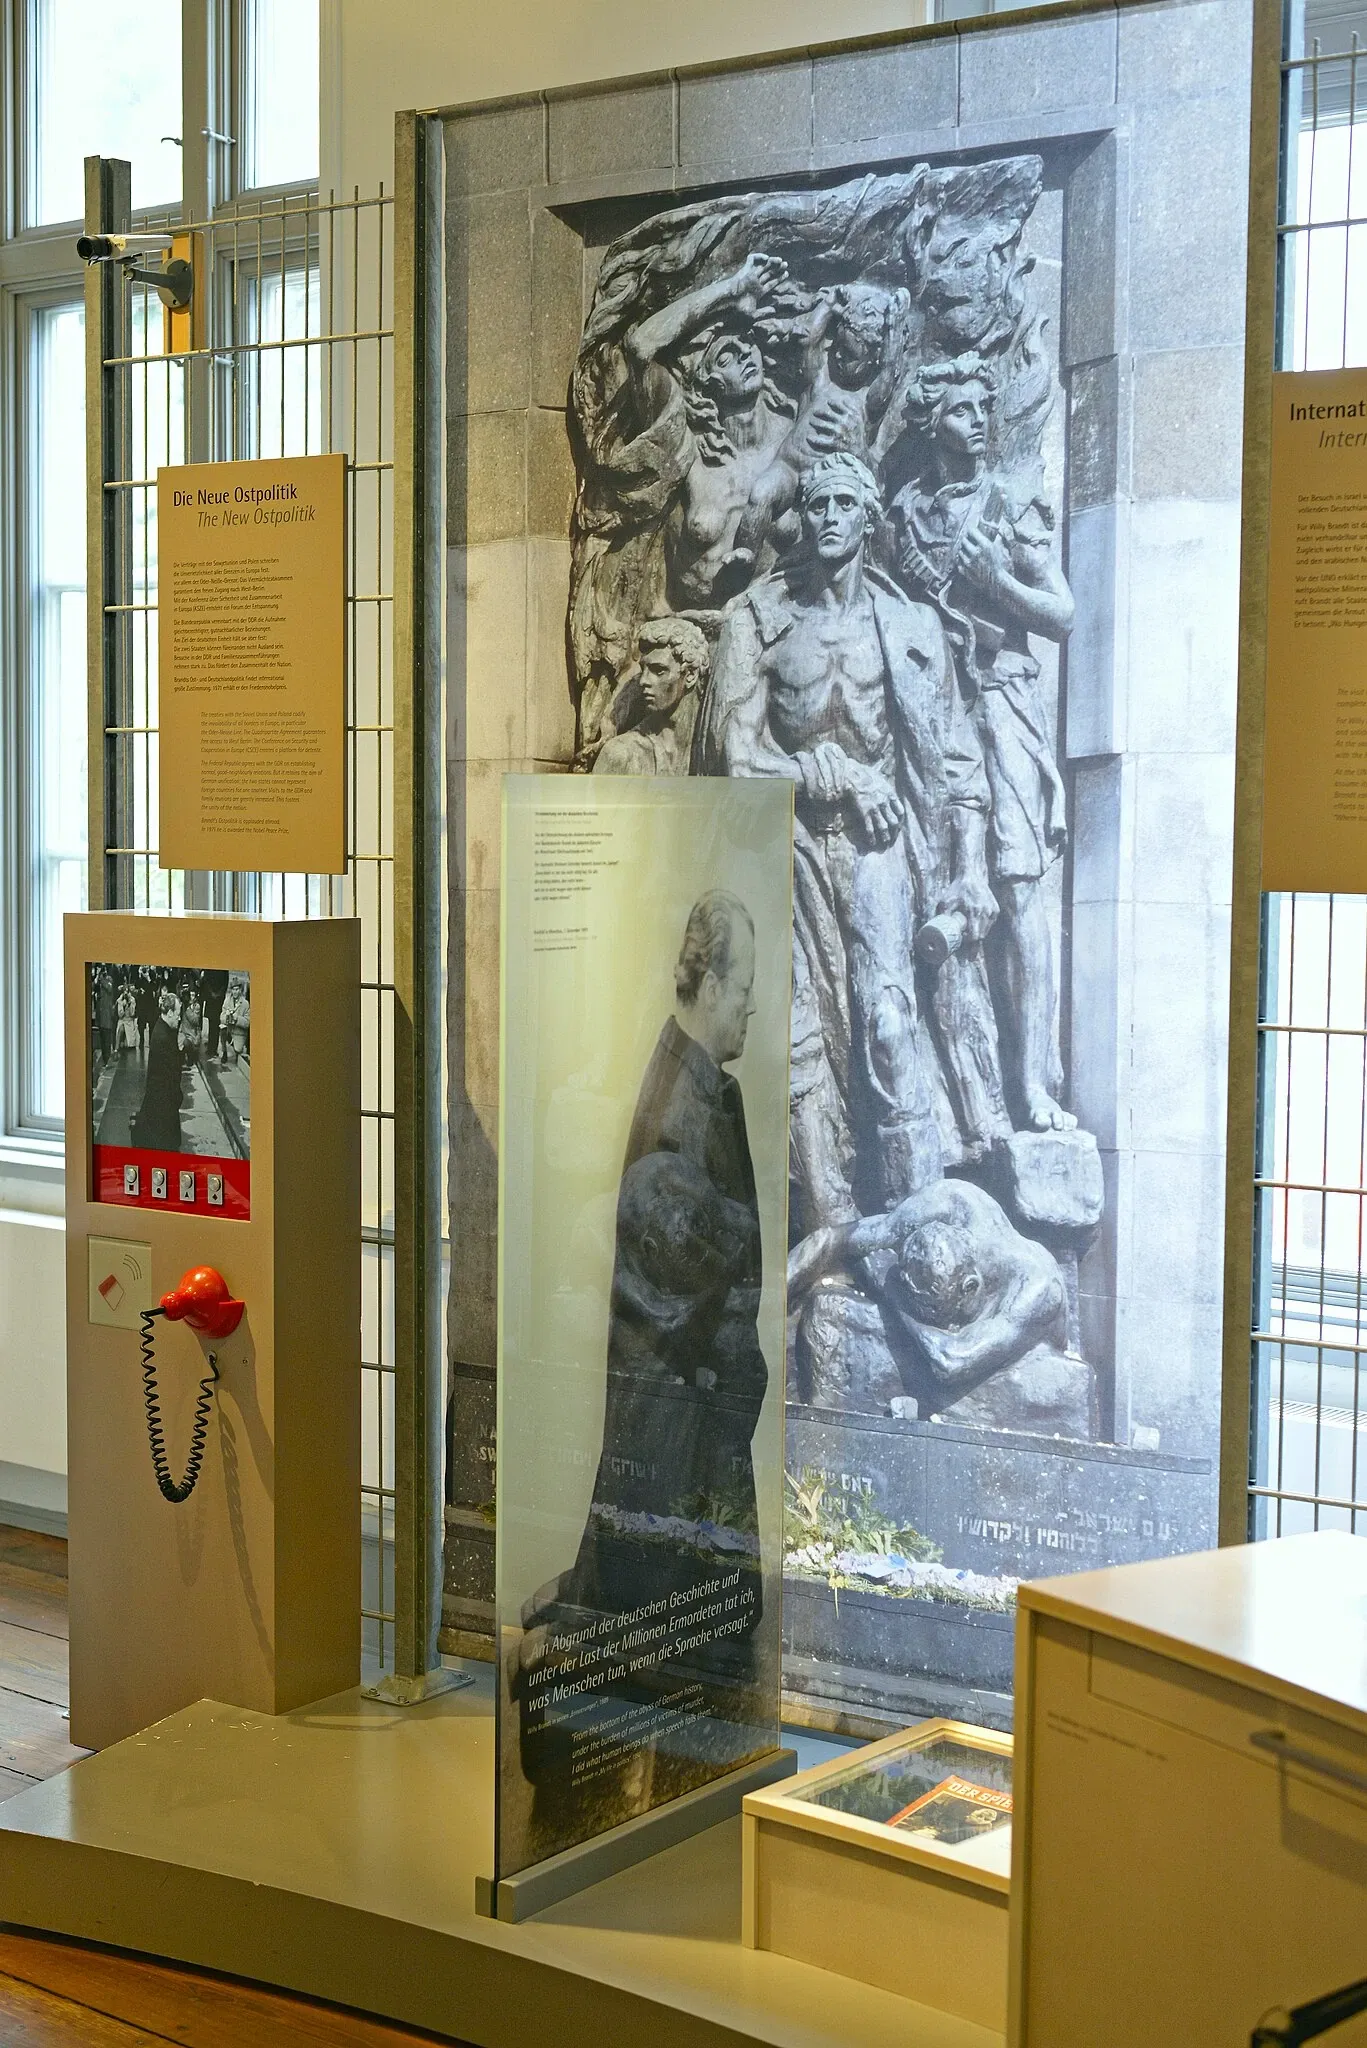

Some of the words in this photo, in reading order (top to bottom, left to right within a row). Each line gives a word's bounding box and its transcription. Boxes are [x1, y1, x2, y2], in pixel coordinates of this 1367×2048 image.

[1291, 400, 1367, 421] Internat
[174, 490, 193, 506] Die
[198, 489, 230, 505] Neue
[234, 484, 298, 506] Ostpolitik
[198, 511, 218, 527] The
[222, 510, 249, 526] New
[254, 506, 316, 526] Ostpolitik
[551, 1621, 597, 1652] Abgrund
[598, 1618, 615, 1635] der
[617, 1599, 667, 1628] deutschen
[670, 1578, 720, 1608] Geschichte
[722, 1568, 740, 1590] und
[528, 1665, 558, 1687] unter
[560, 1658, 577, 1675] der
[579, 1644, 601, 1668] Last
[603, 1641, 620, 1659] der
[621, 1624, 667, 1651] Millionen
[669, 1602, 721, 1633] Ermordeten
[725, 1592, 738, 1612] tat
[740, 1586, 755, 1606] ich,
[528, 1694, 549, 1712] was
[552, 1672, 604, 1702] Menschen
[608, 1665, 626, 1681] tun,
[630, 1652, 657, 1672] wenn
[658, 1644, 673, 1661] die
[674, 1628, 712, 1656] Sprache
[572, 1745, 590, 1758] under
[591, 1740, 599, 1751] the
[600, 1732, 620, 1746] burden
[621, 1727, 629, 1738] of
[629, 1720, 650, 1734] millions
[658, 1708, 677, 1722] victims
[590, 1725, 599, 1735] the
[600, 1717, 620, 1731] bottom
[621, 1712, 628, 1722] of
[629, 1709, 638, 1719] the
[662, 1691, 683, 1705] German
[575, 1760, 585, 1773] did
[586, 1754, 600, 1768] what
[602, 1747, 621, 1761] human
[623, 1738, 641, 1752] beings
[642, 1734, 649, 1744] do
[650, 1728, 665, 1740] when
[666, 1718, 684, 1735] speech
[947, 1782, 981, 1799] DER
